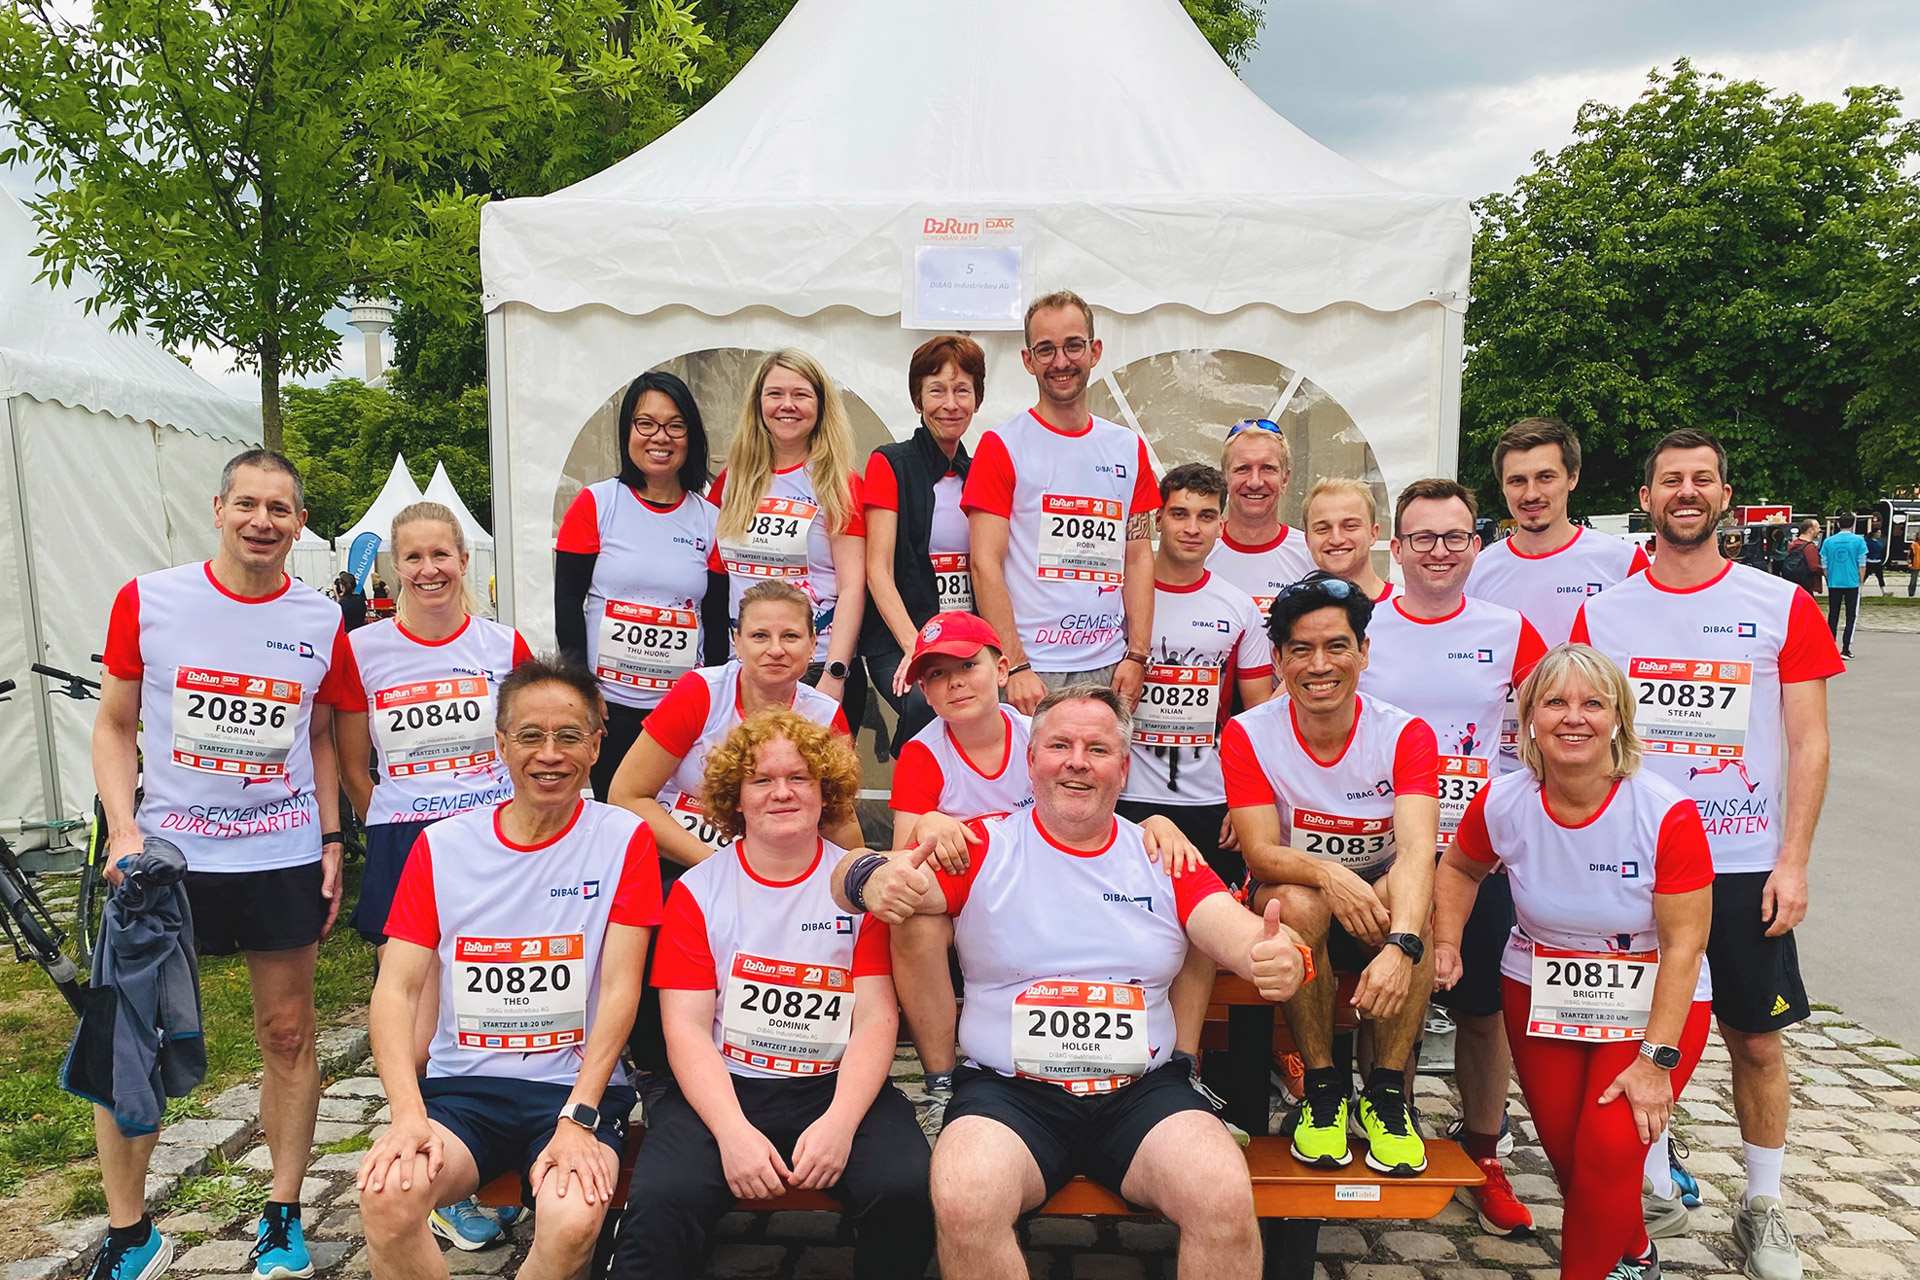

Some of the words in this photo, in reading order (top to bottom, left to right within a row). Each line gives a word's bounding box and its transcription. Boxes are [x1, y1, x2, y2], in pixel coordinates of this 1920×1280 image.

[924, 218, 979, 234] B2Run
[986, 218, 1014, 228] DAK
[966, 264, 974, 274] 5
[954, 282, 998, 290] Industriebau
[1051, 516, 1116, 542] 20842
[936, 575, 970, 595] 081
[1060, 614, 1123, 629] GEMEINS
[611, 622, 688, 650] 20823
[266, 640, 296, 652] DIBAG
[627, 647, 642, 655] THU
[1638, 661, 1668, 671] B2Run
[187, 672, 220, 684] B2Run
[1140, 686, 1210, 706] 20828
[1638, 682, 1736, 710] 20837
[187, 694, 287, 728] 20836
[388, 700, 480, 733] 20840
[1668, 709, 1702, 718] STEFAN
[216, 725, 256, 736] FLORIAN
[198, 744, 234, 754] STARTZEIT
[408, 748, 440, 758] STARTZEIT
[1346, 790, 1374, 800] DIBAG
[1438, 778, 1478, 801] 833
[412, 788, 514, 812] GEMEINSAM
[188, 794, 310, 822] GEMEINSAM
[1696, 797, 1768, 817] EINSAM
[160, 808, 310, 838] DURCHSTARTEN
[1304, 814, 1334, 826] B2Run
[1589, 863, 1618, 872] DIBAG
[550, 887, 578, 897] DIBAG
[802, 921, 832, 932] DIBAG
[464, 942, 492, 953] B2Run
[743, 959, 776, 974] B2Run
[466, 964, 571, 993] 20820
[1546, 961, 1645, 989] 20817
[1026, 985, 1058, 995] B2Run
[1573, 990, 1614, 999] BRIGITTE
[503, 997, 530, 1006] THEO
[740, 984, 841, 1021] 20824
[768, 1018, 810, 1031] DOMINIK
[1028, 1010, 1133, 1040] 20825
[751, 1040, 787, 1051] STARTZEIT
[788, 1045, 807, 1054] 18:20
[1062, 1042, 1100, 1051] HOLGER
